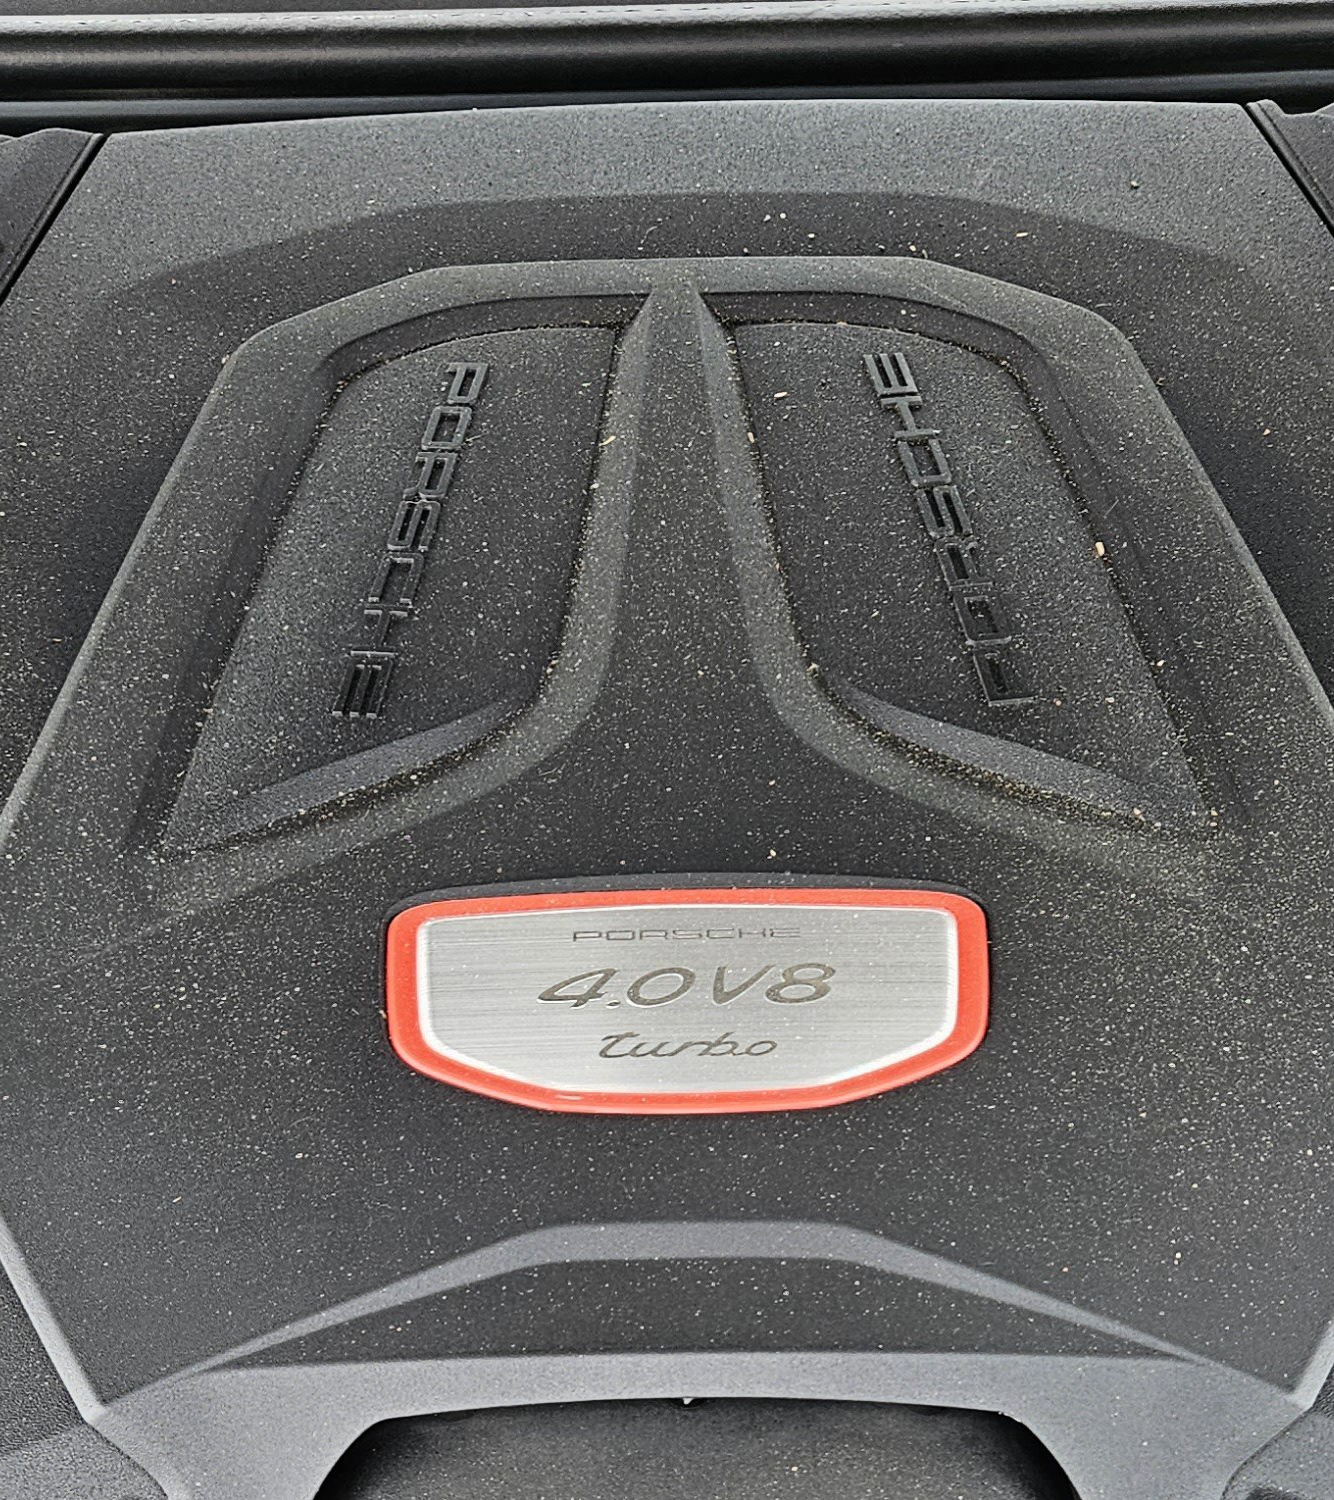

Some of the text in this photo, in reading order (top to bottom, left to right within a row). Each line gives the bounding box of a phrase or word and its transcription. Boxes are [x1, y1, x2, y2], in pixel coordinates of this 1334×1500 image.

[332, 362, 489, 719] PORSCHE
[864, 352, 1034, 707] PORSCHE
[572, 926, 801, 943] PORSCHE
[598, 1031, 778, 1059] turbo
